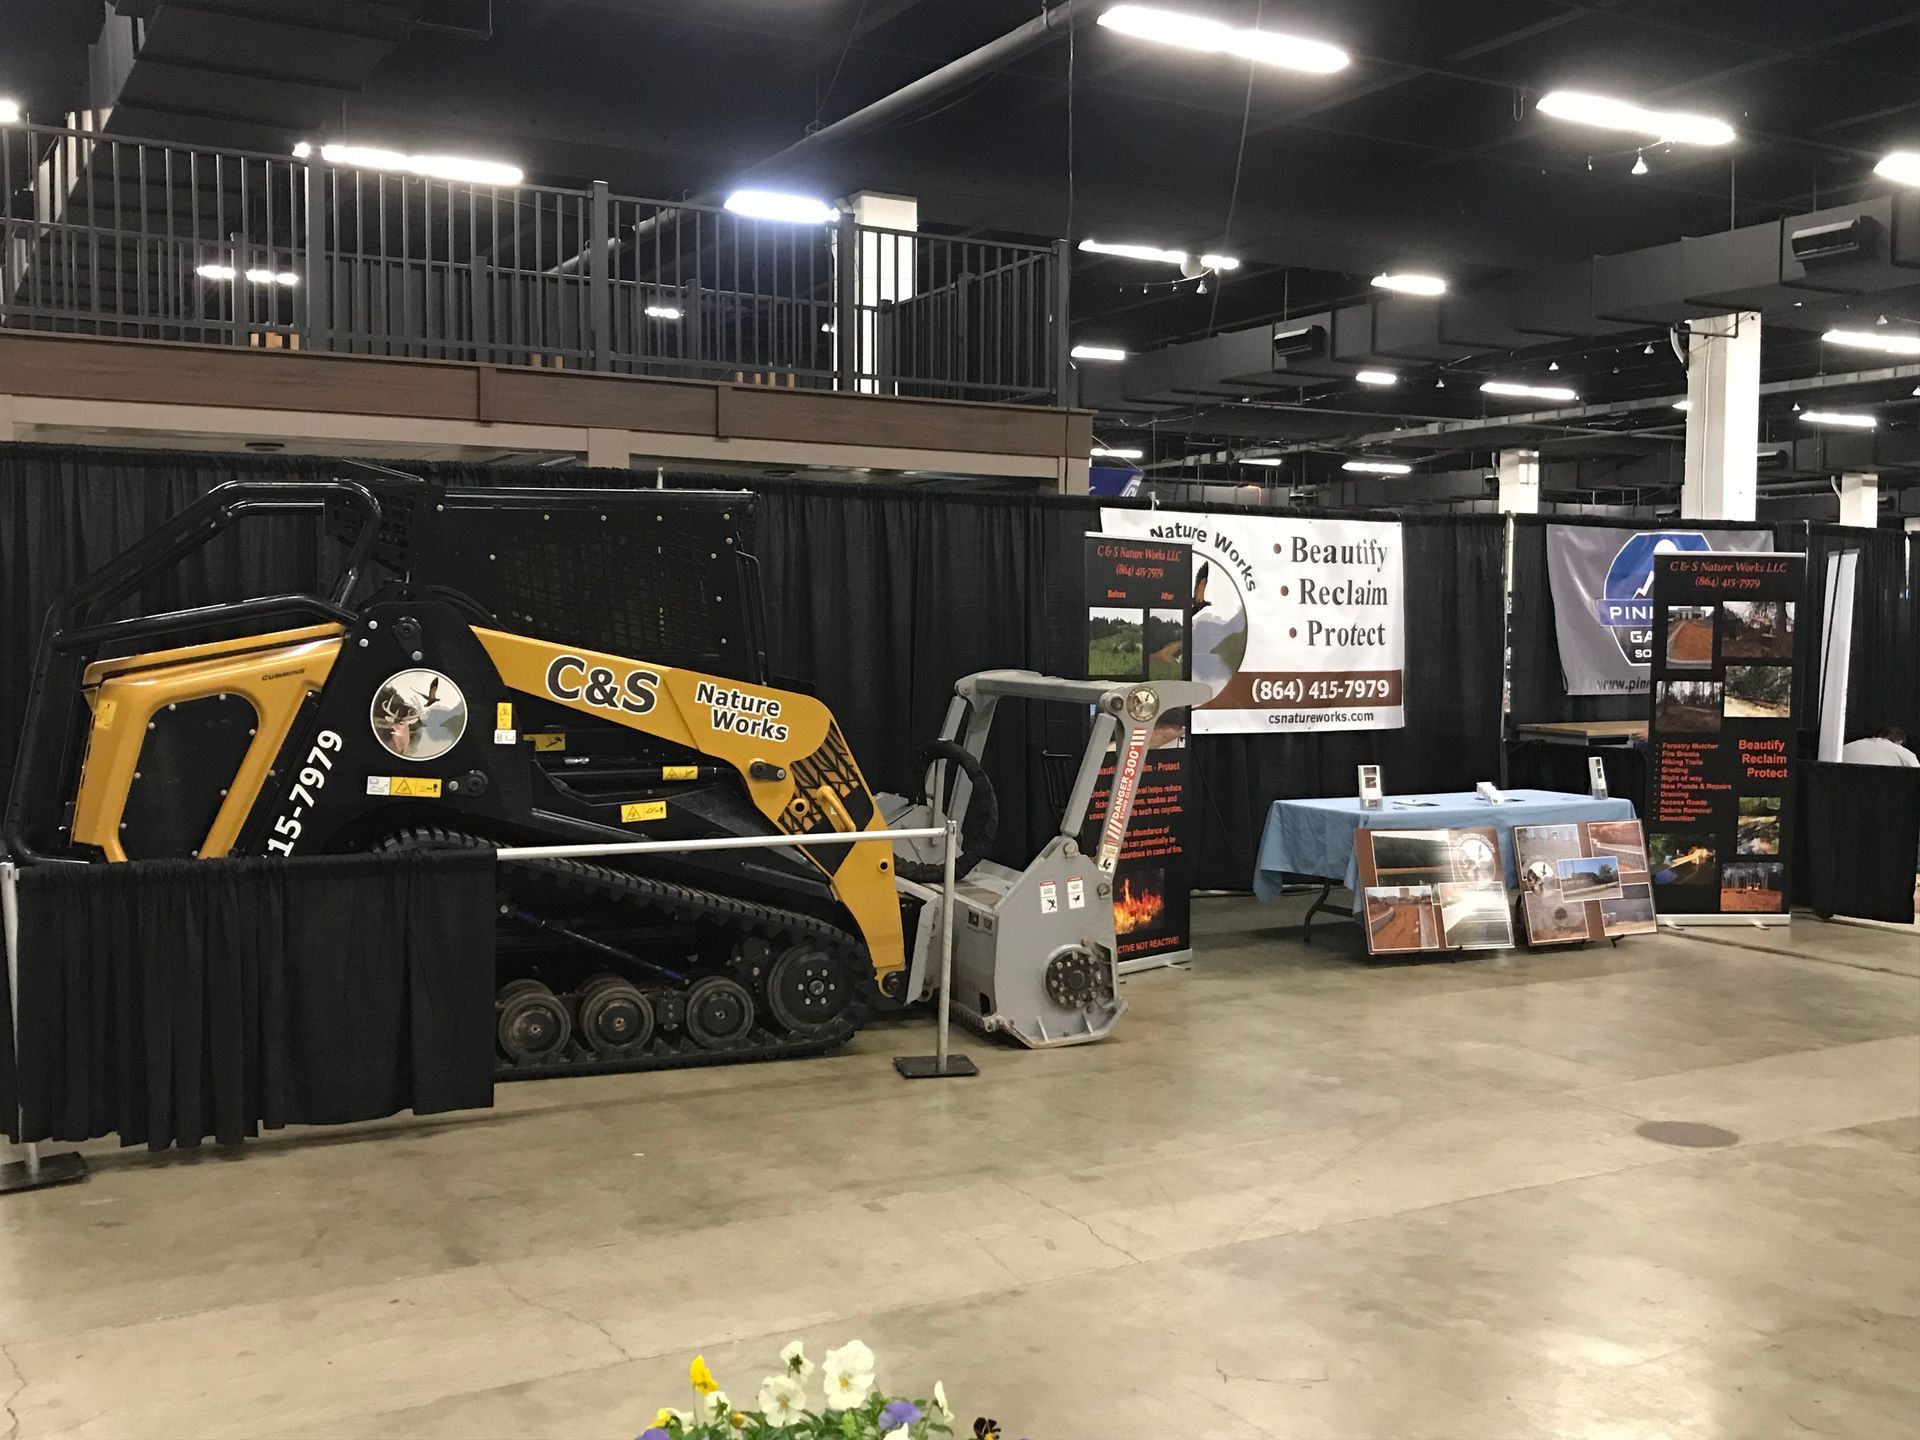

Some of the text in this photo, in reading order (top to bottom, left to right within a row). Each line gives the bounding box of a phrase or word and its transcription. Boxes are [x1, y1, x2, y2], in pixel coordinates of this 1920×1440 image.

[1120, 547, 1144, 559] Nature
[1144, 548, 1166, 560] Works
[1166, 550, 1182, 562] LLC
[1150, 522, 1256, 592] Nature Works
[1291, 536, 1388, 572] Beautify
[1670, 561, 1788, 573] C & S Nature Works LLC
[1299, 578, 1388, 606] Reclaim
[1695, 576, 1760, 588] (864) 415-7979
[1307, 620, 1386, 647] Protect
[262, 668, 306, 680] CUMMINS
[546, 655, 659, 716] C&S
[696, 681, 781, 718] Nature
[1251, 678, 1390, 702] (864) 415-7979
[711, 708, 789, 742] Works
[1268, 710, 1374, 724] csnatureworks.com
[1738, 740, 1785, 752] Beautify
[1742, 754, 1786, 764] Reclaim
[1747, 767, 1788, 778] Protect
[264, 730, 342, 858] 15-7979
[1112, 776, 1130, 820] DANGER
[1117, 944, 1135, 954] CTIVE
